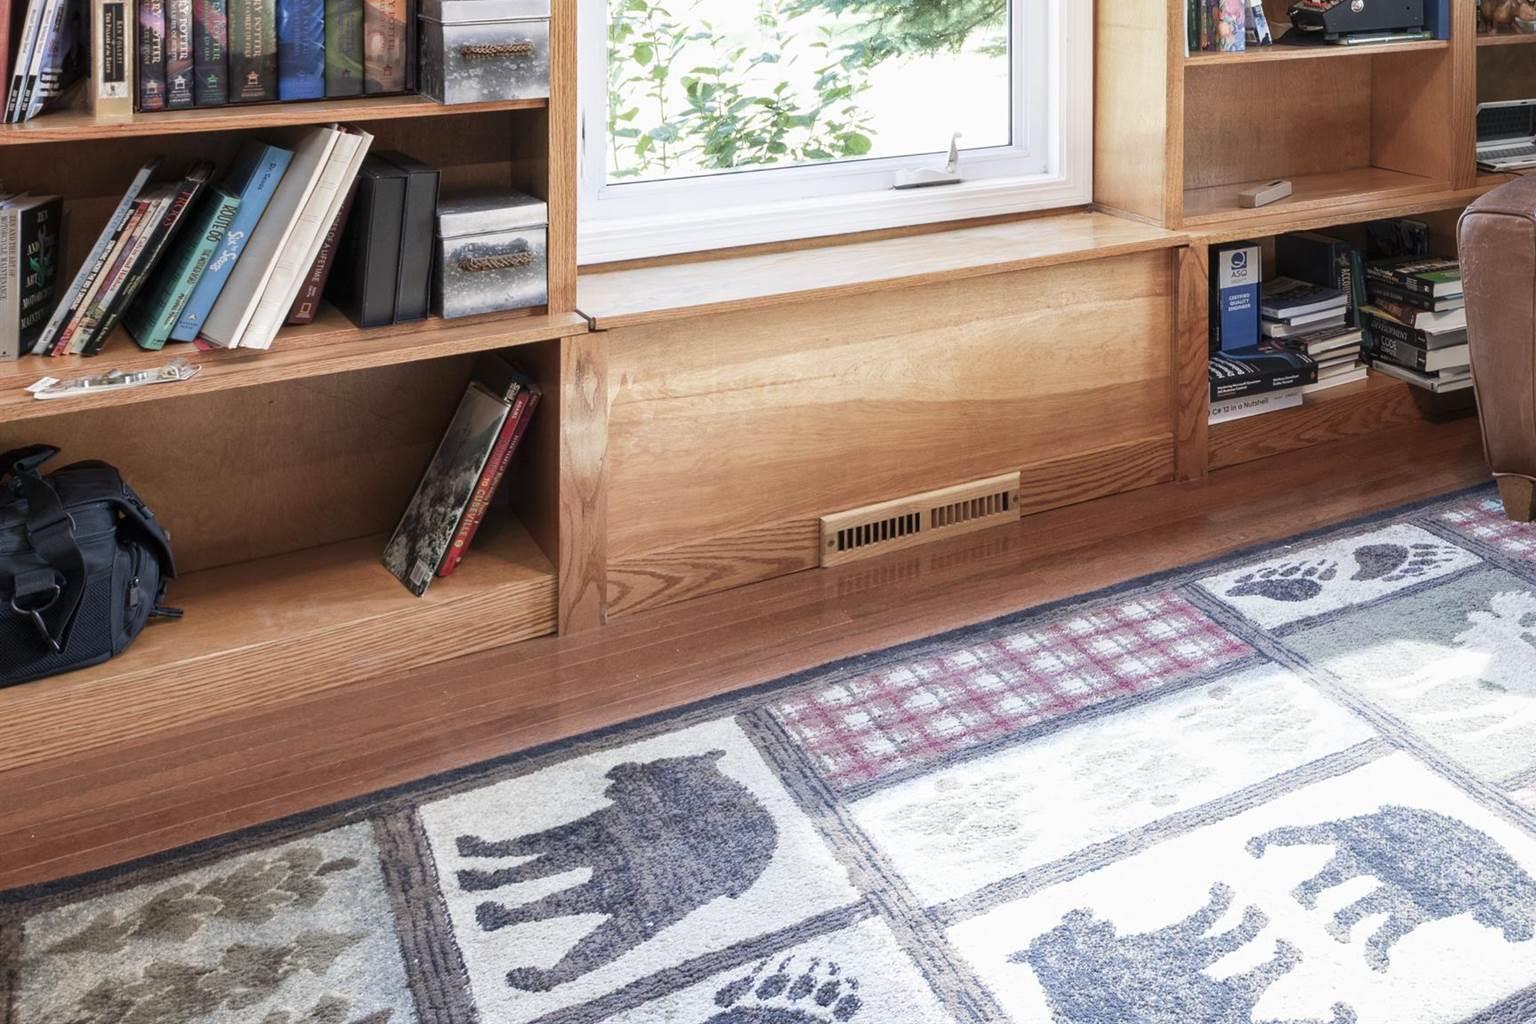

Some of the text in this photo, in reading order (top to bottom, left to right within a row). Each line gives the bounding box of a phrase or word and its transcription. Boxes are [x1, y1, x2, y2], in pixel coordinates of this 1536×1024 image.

[149, 21, 160, 63] POTTER
[178, 17, 188, 60] POTTER
[252, 16, 262, 57] POTTER
[162, 189, 190, 228] FROGS
[206, 203, 236, 244] ROUTE 66
[311, 249, 328, 282] LIFETIME
[1231, 270, 1248, 278] ASQ
[1212, 407, 1221, 415] C#
[1243, 397, 1269, 409] Nutshell
[459, 488, 484, 537] CUBEVILLE
